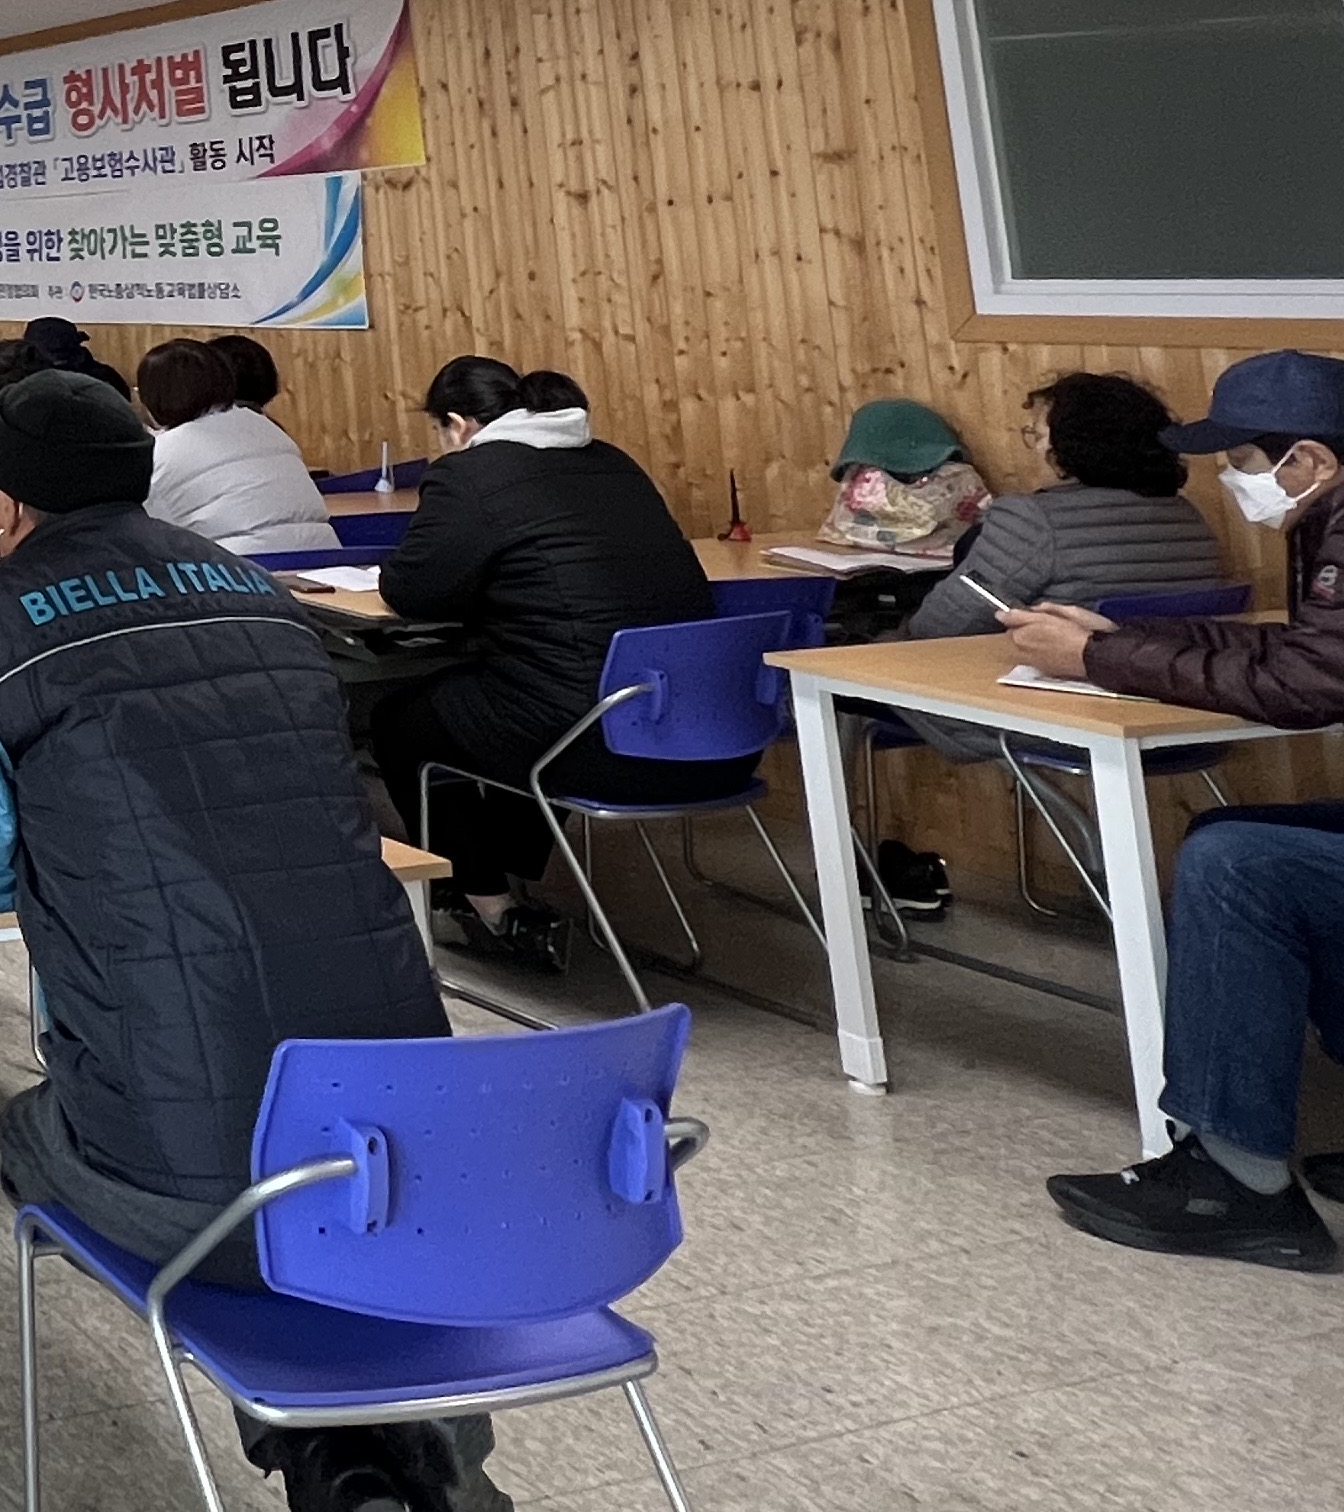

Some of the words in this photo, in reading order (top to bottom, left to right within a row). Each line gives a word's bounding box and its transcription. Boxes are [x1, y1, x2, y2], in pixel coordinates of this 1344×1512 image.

[62, 49, 206, 133] 형사처벌
[220, 22, 352, 110] 됩니다
[188, 140, 228, 172] 활동
[235, 134, 276, 166] 시작
[25, 229, 63, 263] 위한
[67, 223, 151, 261] 찾아가는
[154, 219, 225, 257] 맞춤형
[230, 217, 283, 257] 교육
[19, 566, 166, 627] BIELLA
[166, 562, 277, 596] ITALIA
